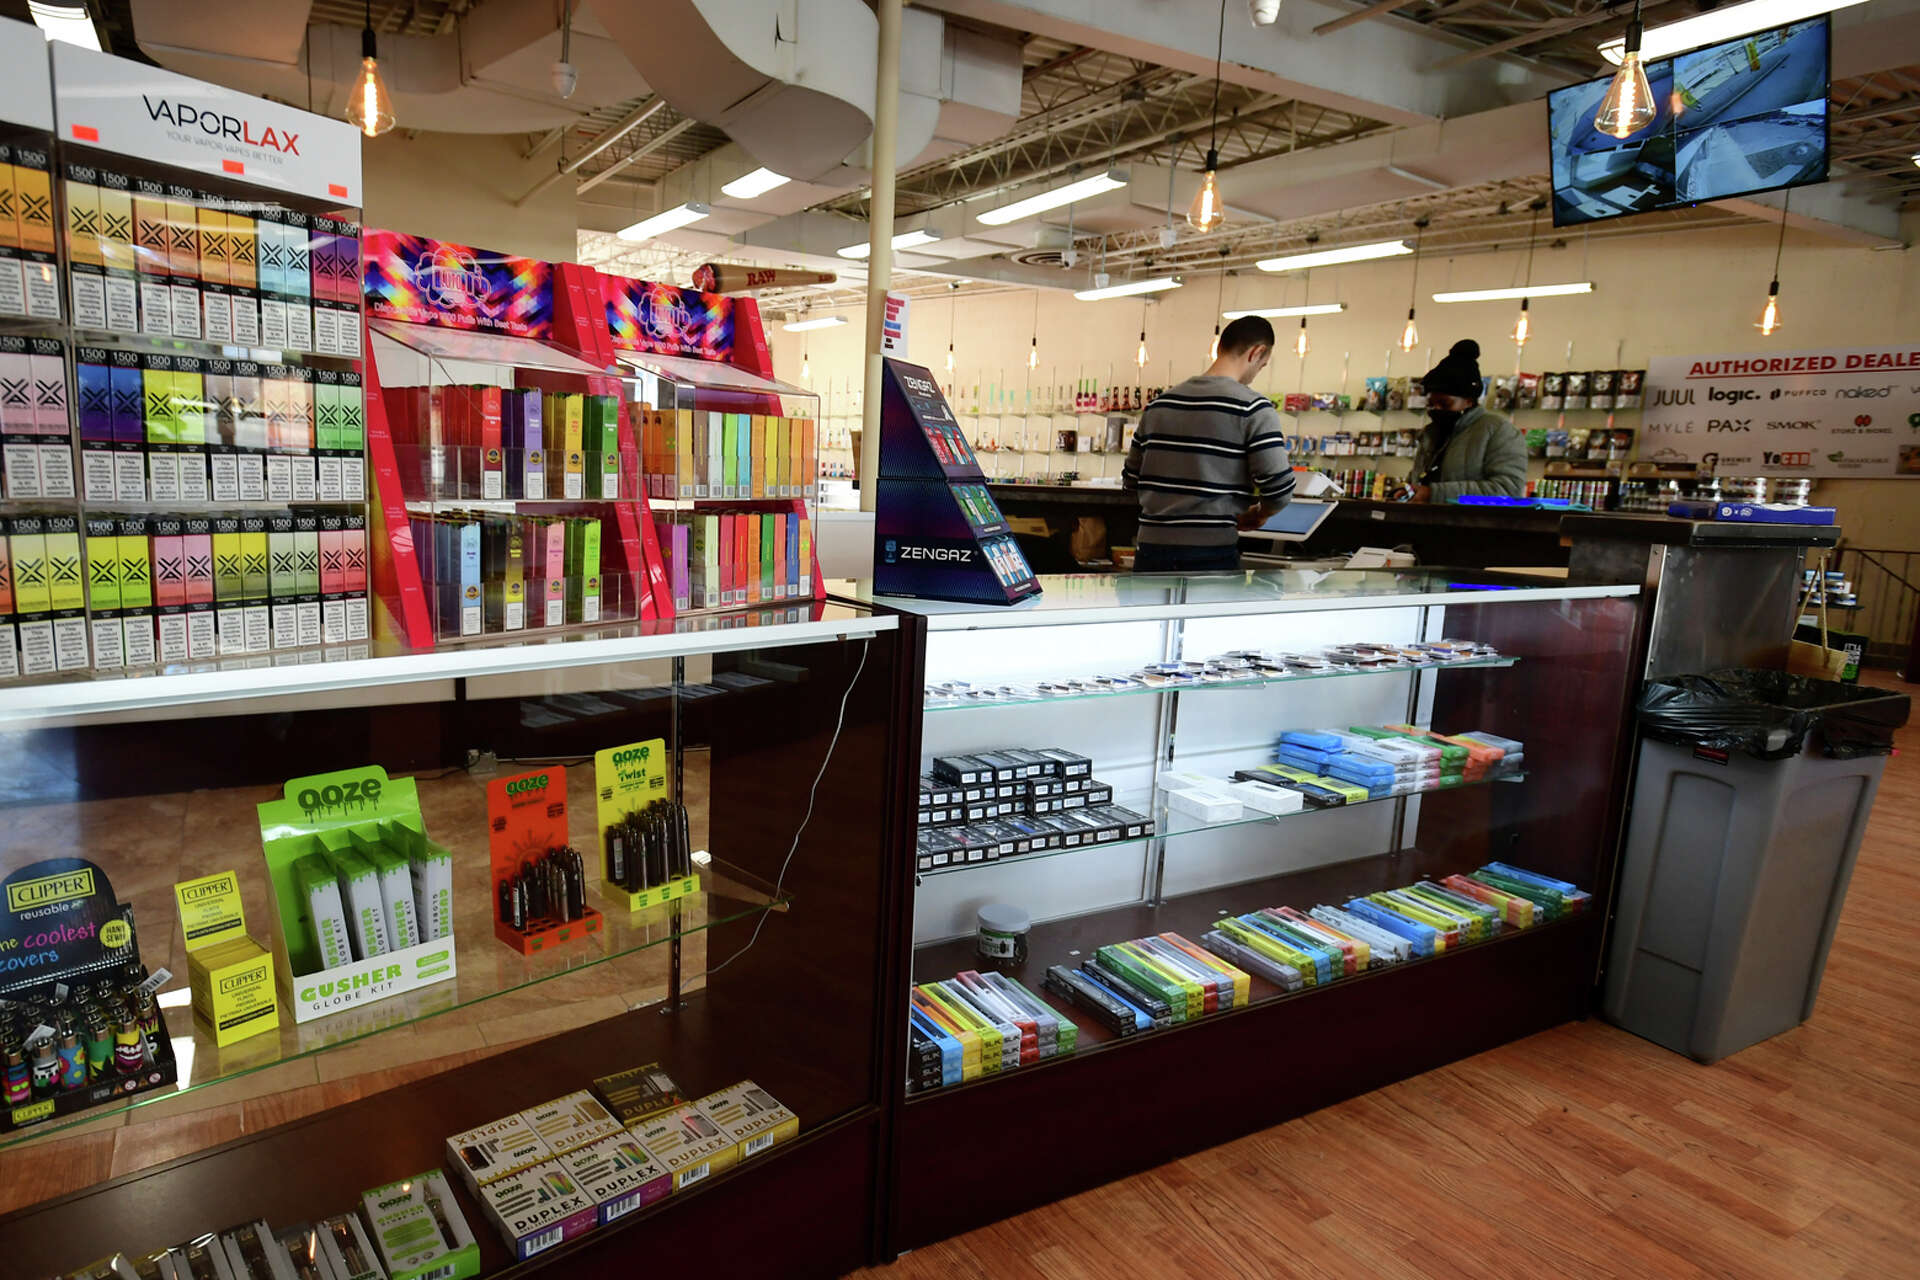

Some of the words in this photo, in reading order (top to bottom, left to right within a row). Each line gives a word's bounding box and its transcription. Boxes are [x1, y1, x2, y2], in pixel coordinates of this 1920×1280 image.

[143, 94, 299, 156] VAPORLAX
[17, 149, 46, 165] 1500
[69, 165, 96, 181] 1500
[101, 172, 128, 187] 1500
[138, 180, 163, 195] 1500
[169, 184, 193, 199] 1500
[286, 210, 307, 224] 1500
[314, 217, 334, 230] 1500
[338, 221, 357, 235] 1500
[746, 270, 776, 286] RAW
[32, 339, 59, 351] 1500
[79, 348, 106, 360] 1500
[113, 351, 138, 363] 1500
[147, 354, 171, 366] 1500
[176, 357, 200, 368] 1500
[209, 360, 231, 370] 1500
[236, 362, 258, 373] 1500
[1689, 356, 1837, 376] AUTHORIZED
[1845, 352, 1920, 369] DEALE
[317, 371, 337, 380] 1500
[341, 373, 360, 383] 1500
[1652, 388, 1696, 407] JUUL
[1784, 388, 1827, 397] PUFFCO
[1706, 419, 1752, 433] PAX
[1766, 420, 1817, 430] SMOK
[12, 519, 41, 530] 1500
[47, 517, 74, 529] 1500
[88, 521, 114, 532] 1500
[120, 520, 144, 531] 1500
[156, 521, 180, 531] 1500
[186, 520, 209, 530] 1500
[216, 519, 238, 529] 1500
[243, 519, 264, 529] 1500
[272, 518, 292, 528] 1500
[296, 518, 316, 527] 1500
[322, 517, 341, 527] 1500
[346, 516, 364, 526] 1500
[900, 546, 973, 562] ZENGAZ
[612, 746, 650, 766] ooze
[506, 774, 549, 795] ooze
[297, 778, 382, 814] ooze
[17, 876, 86, 903] CLIPPER
[186, 880, 228, 900] CLIPPER
[20, 903, 70, 921] reusable
[439, 888, 449, 938] GUSHE
[393, 899, 409, 948] USHER
[23, 921, 97, 949] coolest
[361, 907, 378, 956] USHER
[321, 918, 340, 967] USHER
[0, 950, 59, 973] covers
[223, 970, 264, 991] CLIPPER
[301, 963, 403, 1002] GUSHER
[312, 990, 362, 1011] GLOBE
[371, 981, 394, 995] KIT
[922, 1052, 941, 1063] SLK
[922, 1066, 941, 1076] SLK
[922, 1079, 941, 1088] SLK
[733, 1109, 788, 1137] DUPLEX
[456, 1119, 519, 1146] DUPLEX
[554, 1121, 615, 1148] DUPLEX
[668, 1136, 727, 1167] DUPLEX
[595, 1164, 659, 1197] DUPLEX
[514, 1196, 583, 1231] DUPLEX
